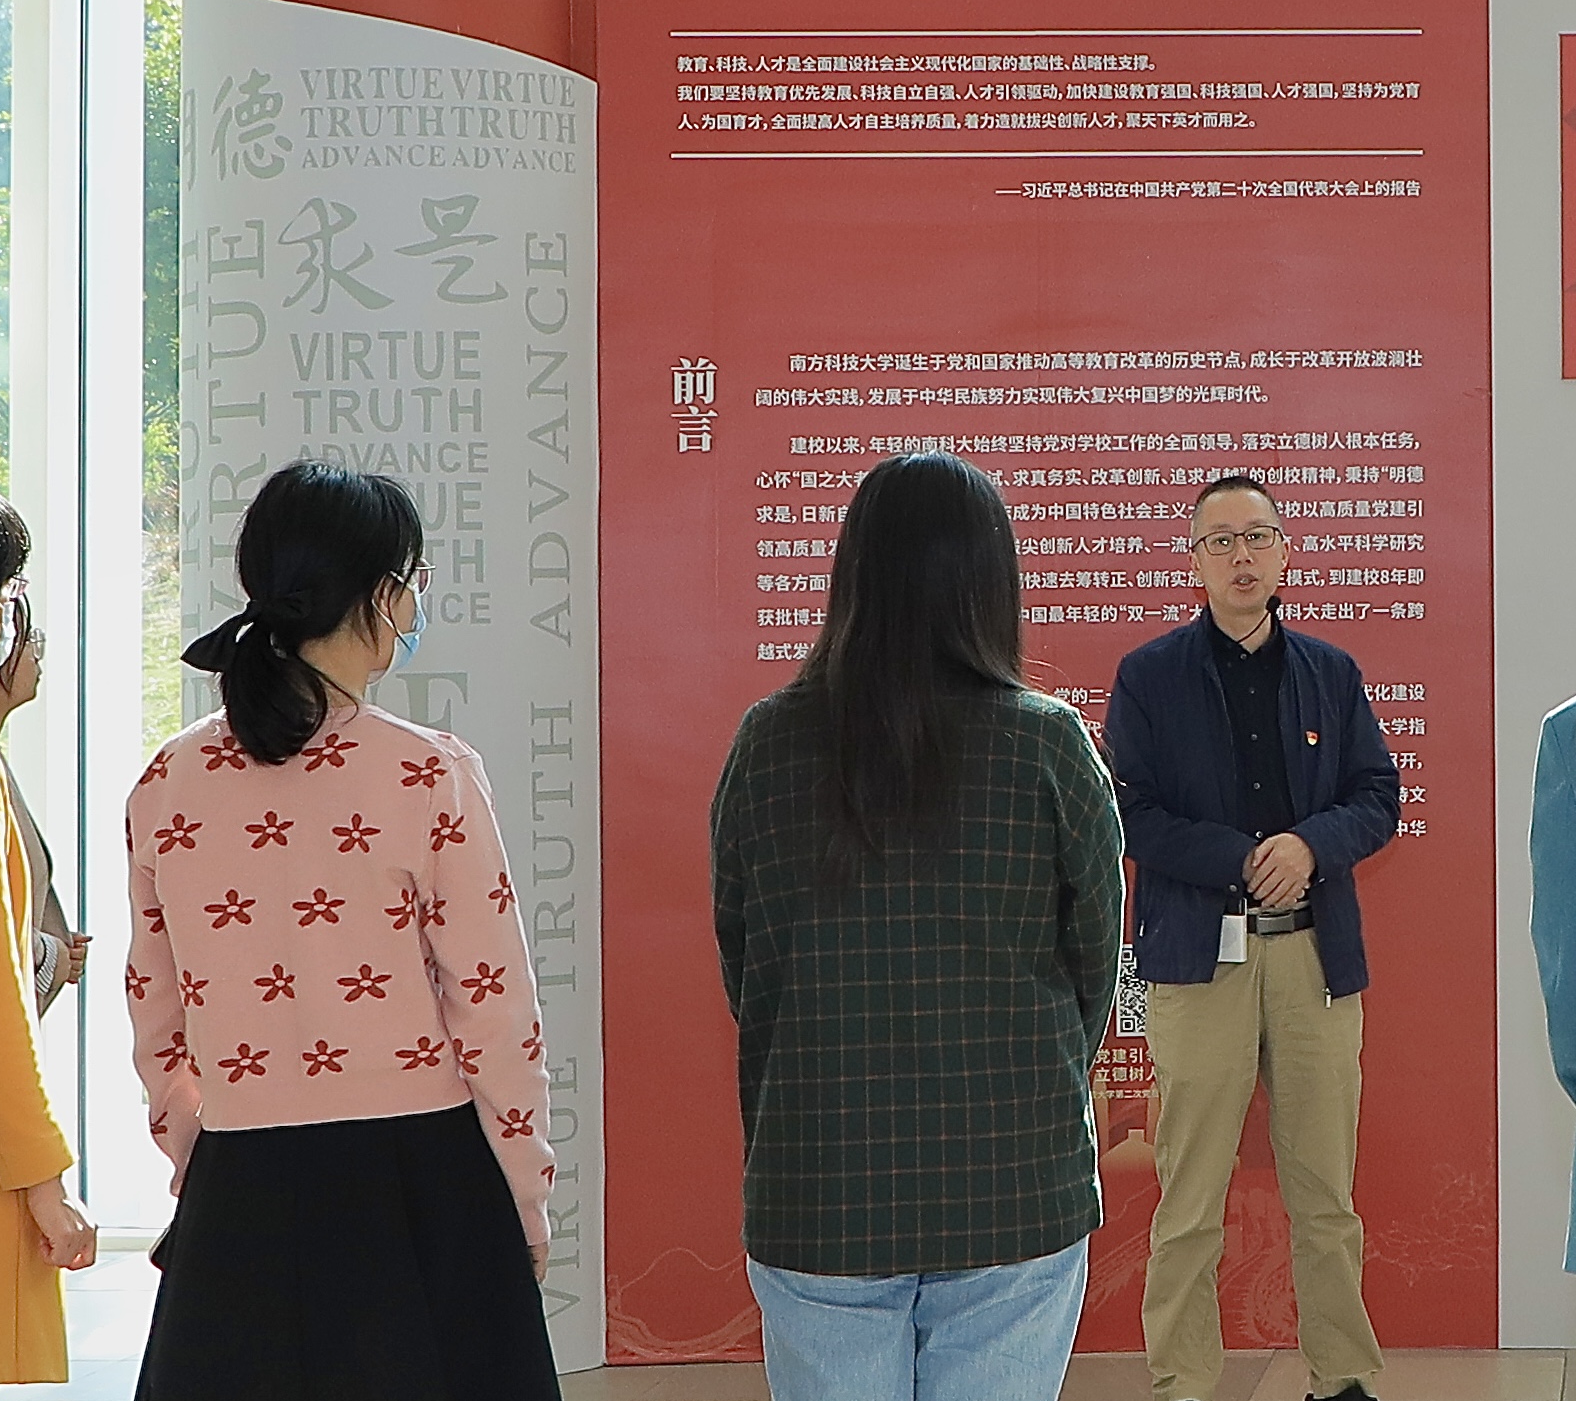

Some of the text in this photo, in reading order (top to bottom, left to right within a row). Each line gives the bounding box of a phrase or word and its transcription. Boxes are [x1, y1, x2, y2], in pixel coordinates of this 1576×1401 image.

[677, 54, 1157, 73] 教育、科技、人才是全面建设社会主义现代化国家的基础性、战略性支撑。
[300, 66, 577, 108] VIRTUE VIRTUE
[677, 83, 1421, 102] 我们要坚持教育优先发展、科技自立自强、人才引领驱动，加快建设教育强国、科技强国、人才强国，坚持为党育
[300, 104, 577, 145] TRUTH TRUTH
[677, 112, 1258, 131] 人、为国育才，全面提高人才自主培养质量，着力造就拔尖创新人才，聚天下英才而用之。
[301, 144, 577, 174] ADVANCE ADVANCE
[995, 180, 1421, 200] ——习近平总书记在中国共产党第二十次全国代表大会上的报告
[291, 331, 483, 383] VIRTUE
[789, 349, 1423, 373] 南方科技大学诞生于党和国家推动高等教育改革的历史节点，成长于改革开放波澜壮
[670, 356, 719, 454] 前言
[754, 384, 1270, 408] 阔的伟大实践，发展于中华民族努力实现伟大复兴中国梦的光辉时代。
[291, 388, 484, 437] TRUTH
[525, 231, 573, 649] ADVANCE
[789, 432, 1421, 456] 建校以来，年轻的南科大始终坚持党对学校工作的全面领导，落实立德树人根本任务，
[295, 441, 490, 475] ADVANCE
[1014, 537, 1194, 556] 尖创新人才培养、一流
[1284, 535, 1425, 554] 、高水平科学研究
[756, 574, 832, 592] 等各方面
[757, 643, 815, 661] 越式发
[531, 699, 580, 1011] TRUTH
[1096, 1047, 1154, 1064] 党建引
